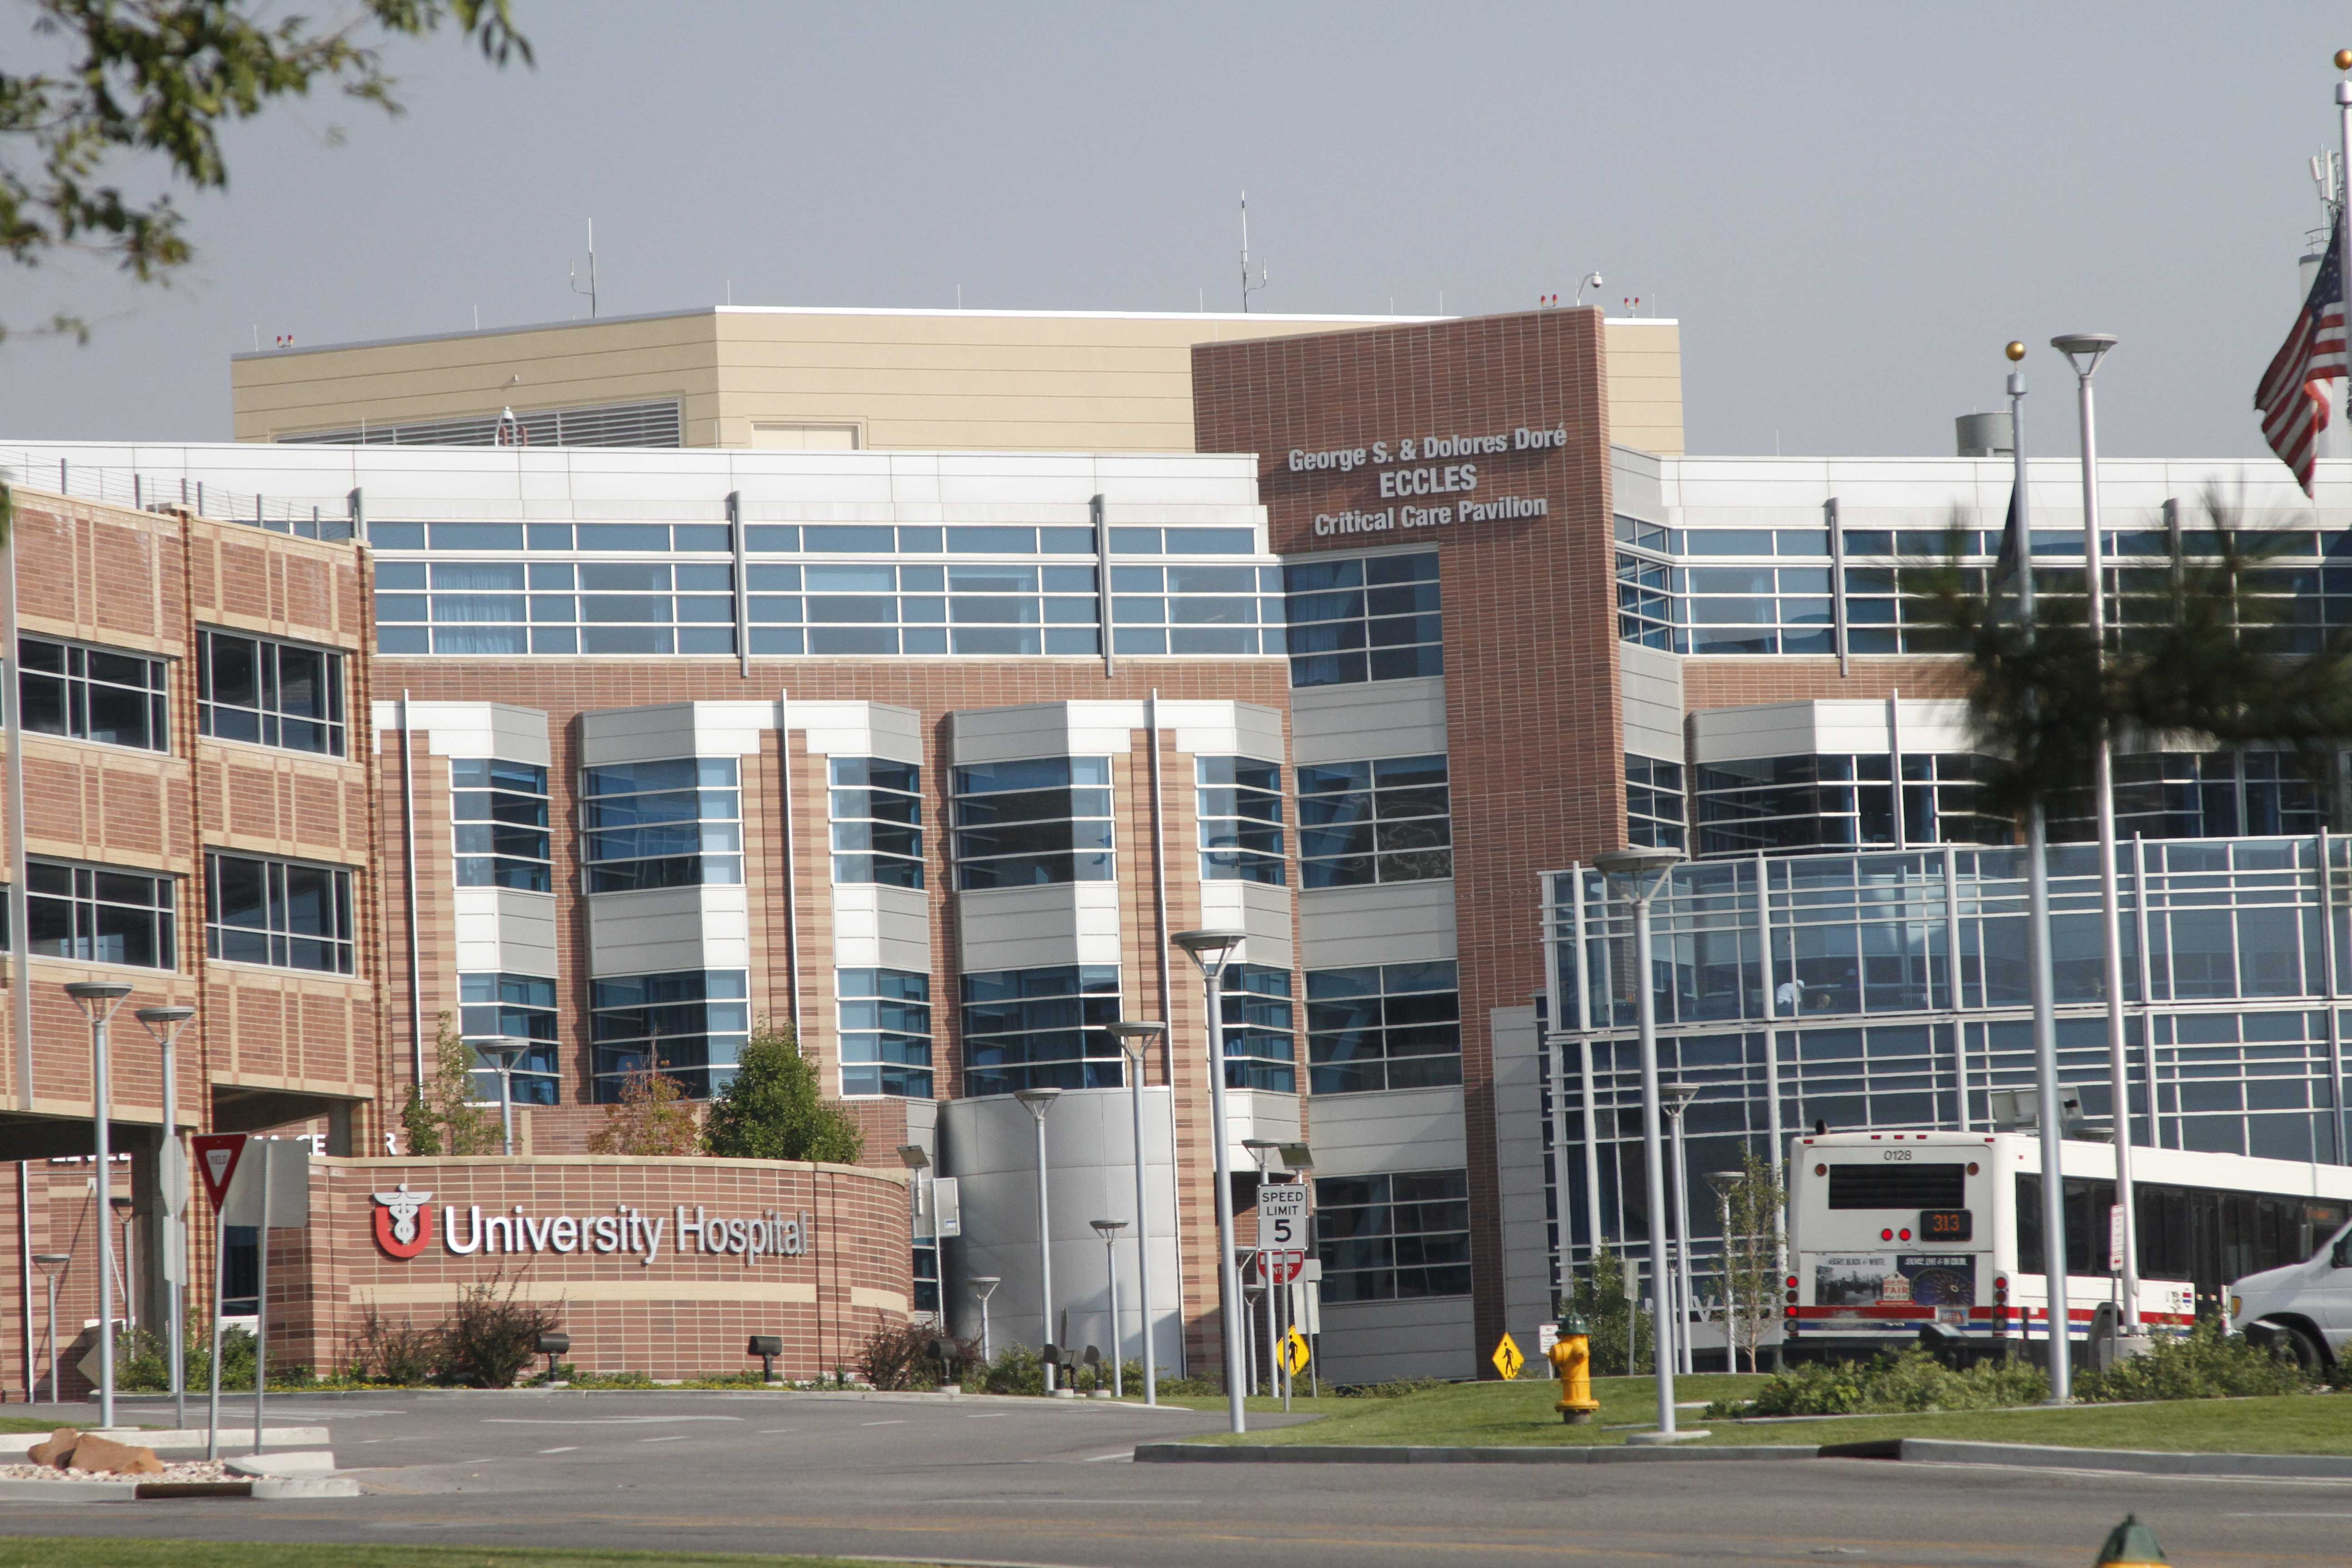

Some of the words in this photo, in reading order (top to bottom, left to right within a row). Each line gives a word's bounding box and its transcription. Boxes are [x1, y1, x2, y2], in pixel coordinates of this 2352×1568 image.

[1289, 447, 1367, 472] George
[1372, 441, 1393, 464] S.
[1400, 438, 1416, 461] &
[1424, 434, 1508, 458] Dolores
[1514, 421, 1568, 450] Doré
[1380, 464, 1478, 498] ECCLES
[1316, 507, 1394, 536] Critical
[1401, 505, 1452, 528] Care
[1458, 496, 1548, 522] Pavilion
[1884, 1150, 1912, 1161] 0128
[1263, 1192, 1303, 1202] SPEED
[1267, 1205, 1298, 1216] LIMIT
[1274, 1219, 1292, 1243] 5
[1933, 1214, 1960, 1231] 313
[445, 1205, 664, 1264] University
[676, 1205, 808, 1265] Hospital
[1272, 1266, 1293, 1274] NTR
